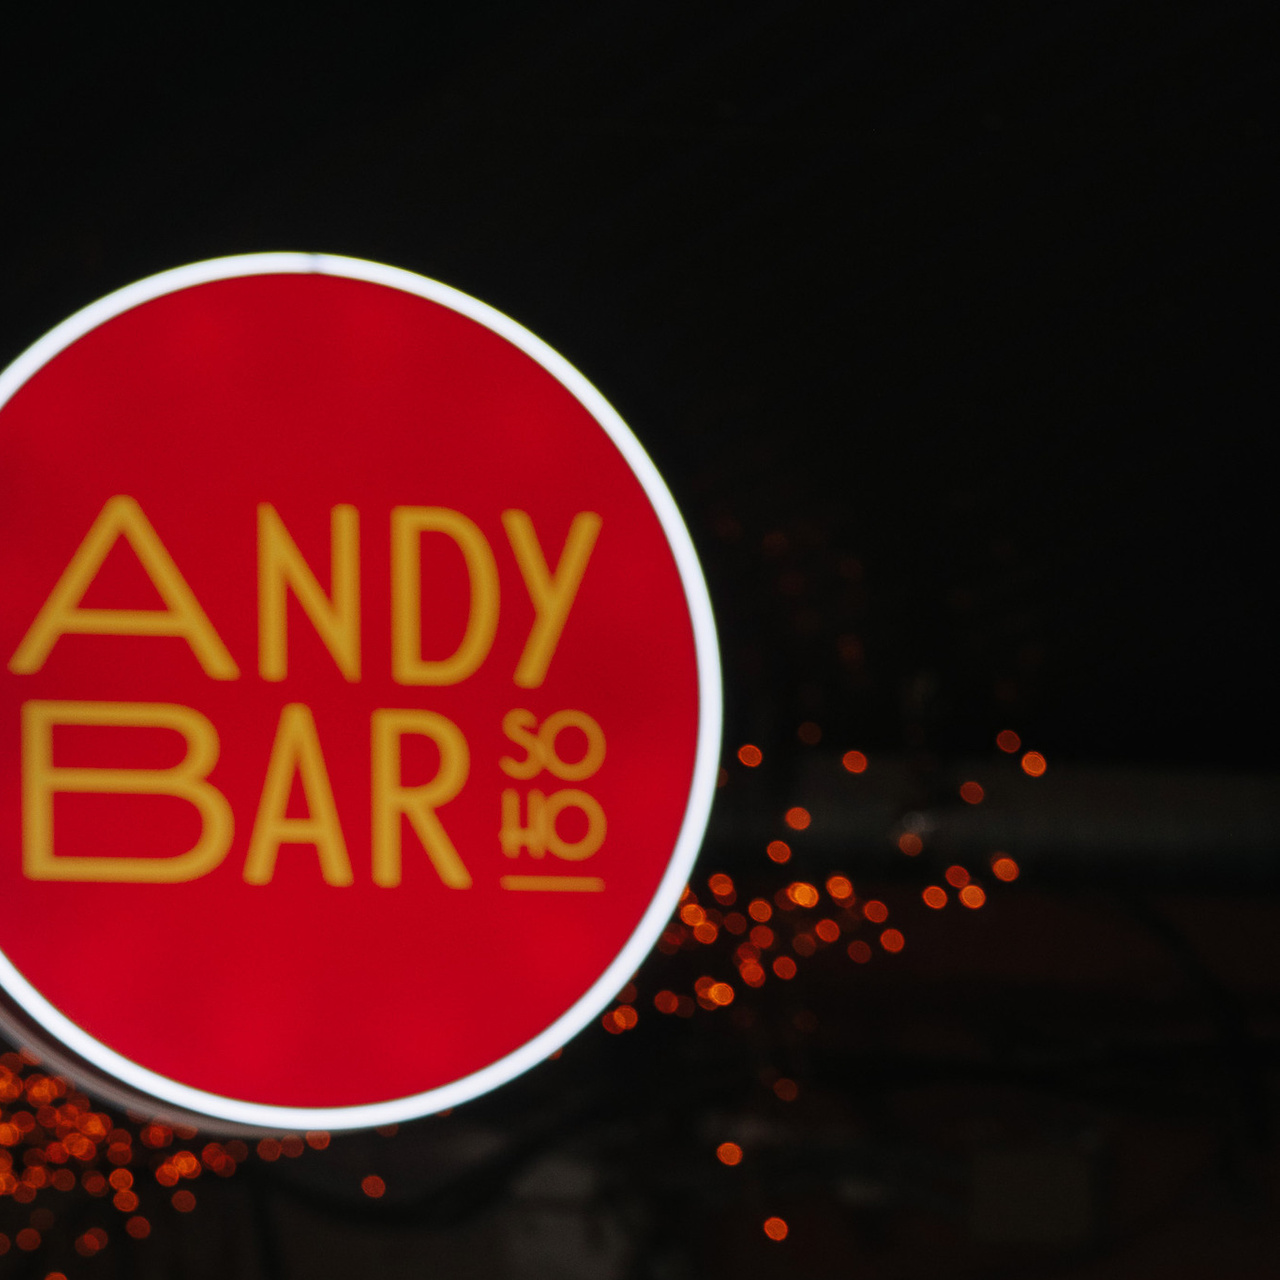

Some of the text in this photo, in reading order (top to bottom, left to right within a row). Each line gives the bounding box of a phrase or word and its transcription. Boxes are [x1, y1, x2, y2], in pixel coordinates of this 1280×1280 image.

[7, 494, 603, 689] ANDY
[21, 700, 472, 890] BAR
[498, 707, 607, 781] SO
[498, 788, 608, 861] HO
